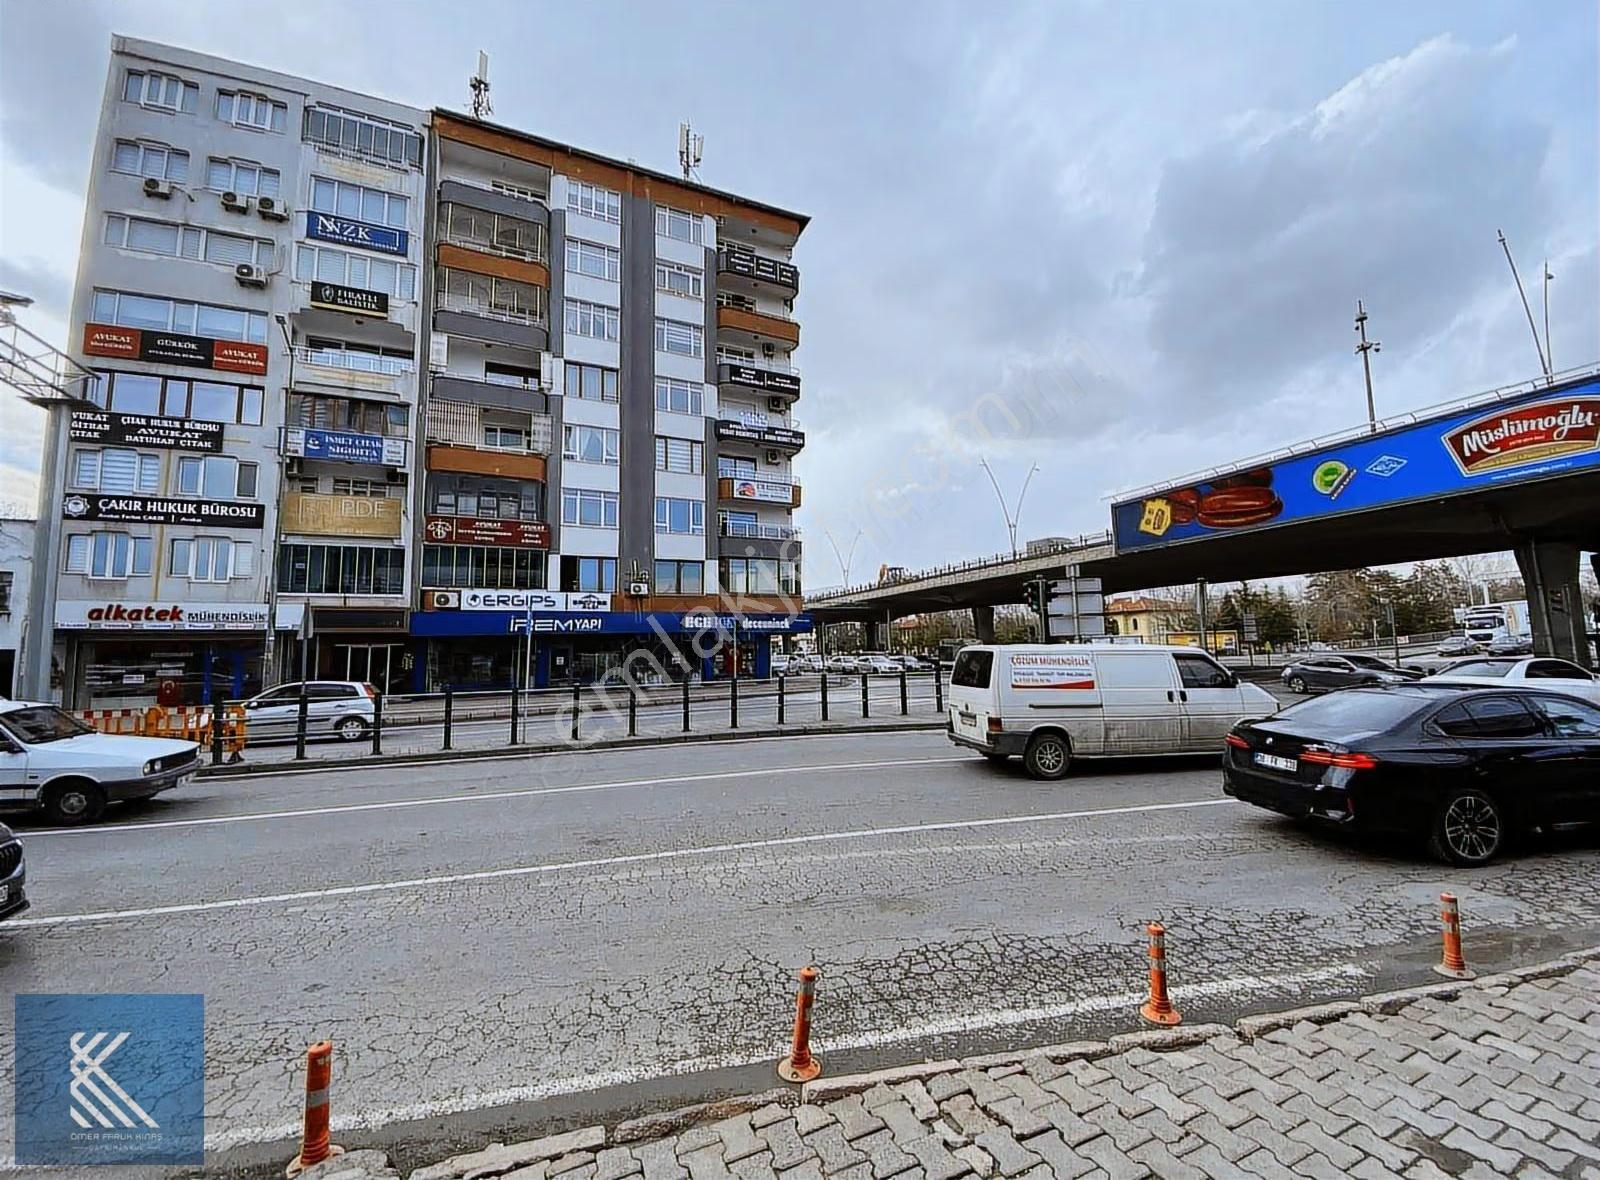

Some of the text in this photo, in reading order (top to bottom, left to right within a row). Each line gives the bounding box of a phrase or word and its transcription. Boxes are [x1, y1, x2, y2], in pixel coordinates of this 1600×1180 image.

[93, 332, 132, 343] AVUKAT
[222, 349, 258, 360] AVUKAT
[71, 411, 110, 422] VUKAT
[150, 418, 180, 429] HUKUK
[184, 421, 219, 432] BÜROSU
[137, 428, 203, 439] AVUKAT
[98, 498, 257, 518] ÇAKIR HUKUK BÜROSU
[87, 604, 267, 622] alkatek MÜHENDİSLİK
[574, 618, 602, 630] YAPI
